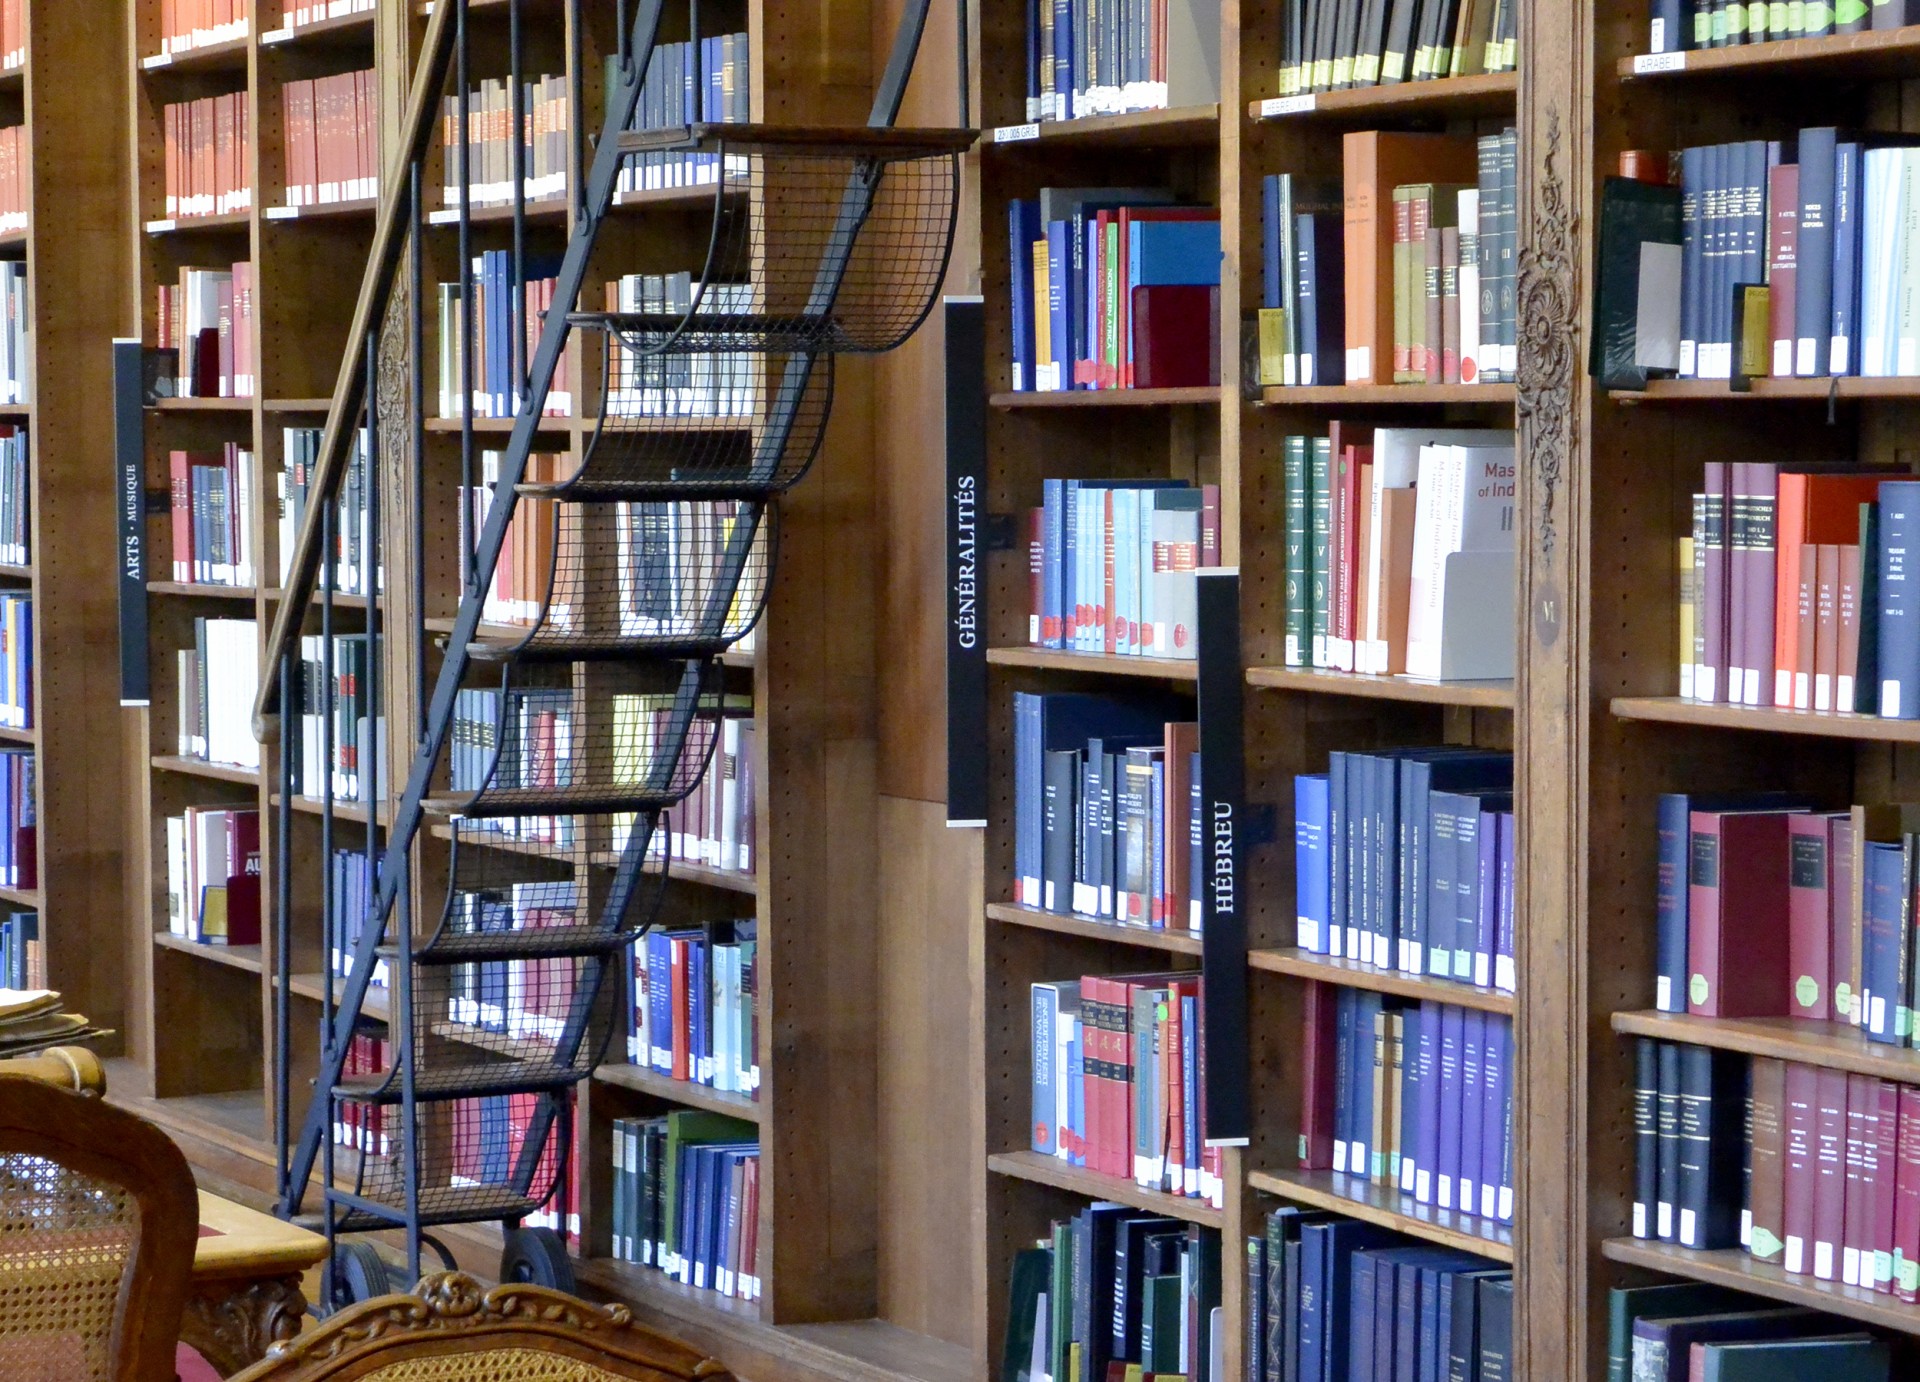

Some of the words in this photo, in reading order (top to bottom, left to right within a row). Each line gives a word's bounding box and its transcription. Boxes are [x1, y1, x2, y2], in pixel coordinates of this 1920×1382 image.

[1640, 56, 1671, 71] ARABE
[126, 464, 137, 522] MUSIQUE
[1436, 460, 1445, 507] Masters
[1453, 460, 1462, 507] Masters
[1478, 486, 1490, 497] of
[126, 535, 141, 580] ARTS
[953, 476, 976, 649] GÉNÉRALITÉS
[1429, 562, 1440, 608] Painting
[1210, 801, 1234, 914] HÉBREU
